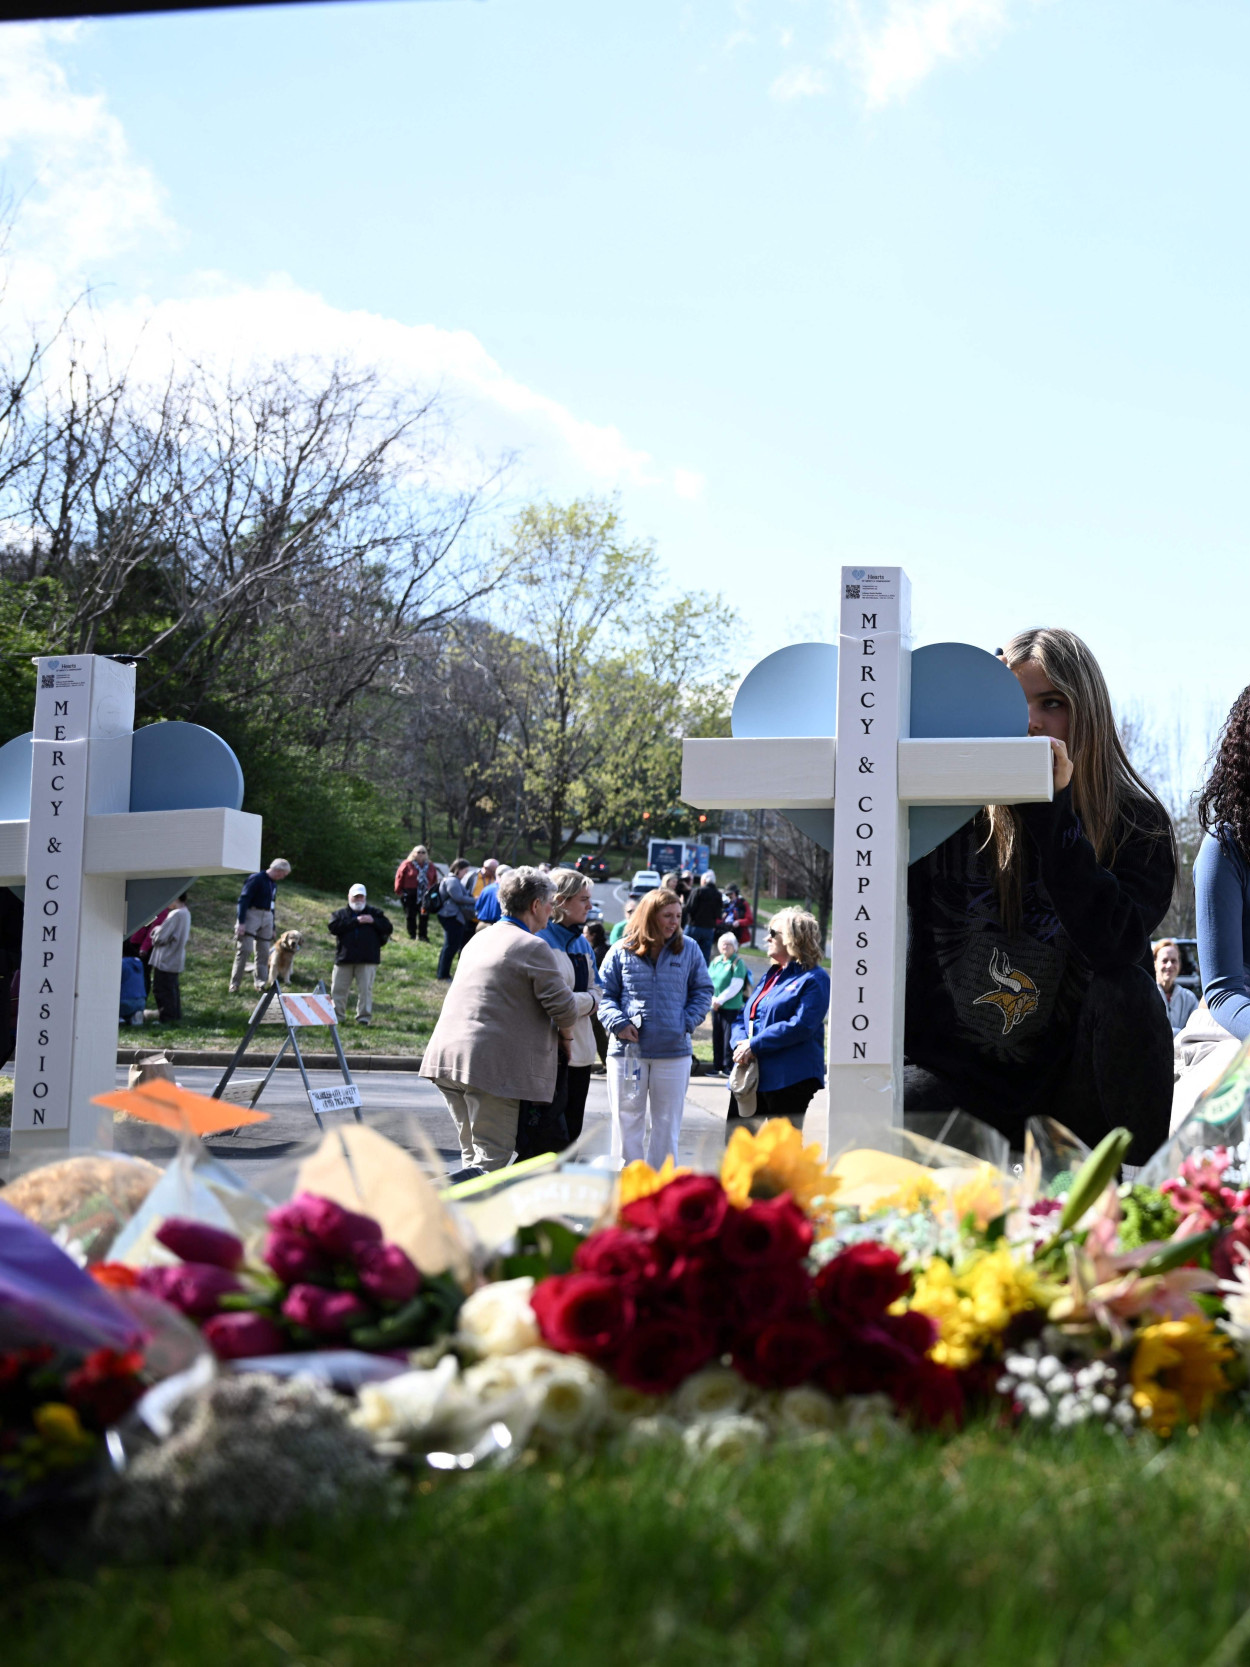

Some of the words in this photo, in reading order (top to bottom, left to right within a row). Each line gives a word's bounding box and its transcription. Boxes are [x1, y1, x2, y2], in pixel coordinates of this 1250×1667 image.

[860, 613, 878, 735] MERCY
[50, 700, 69, 817] MERCY
[858, 756, 875, 774] &
[46, 836, 63, 854] &
[851, 796, 874, 1059] COMPASSION
[32, 874, 60, 1125] COMPASSION
